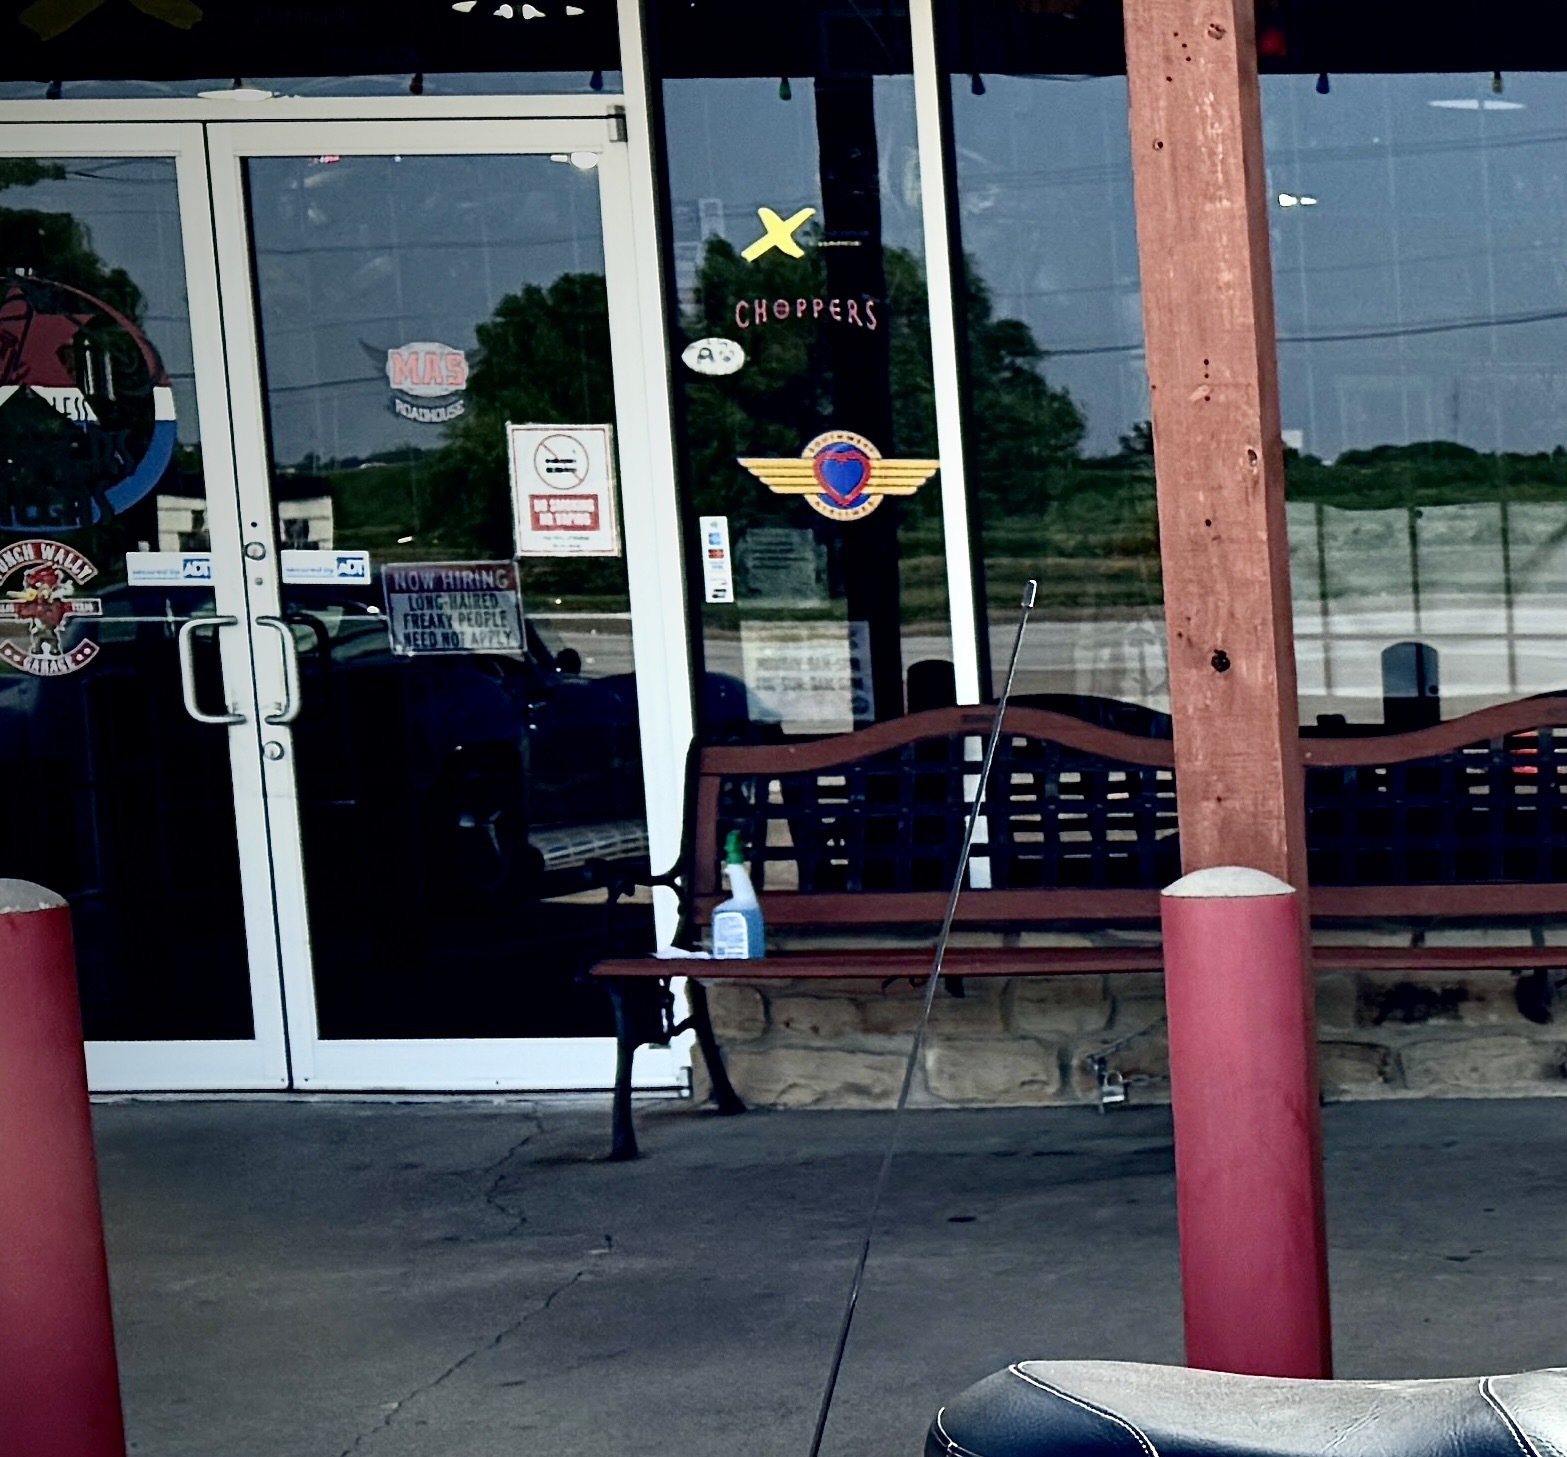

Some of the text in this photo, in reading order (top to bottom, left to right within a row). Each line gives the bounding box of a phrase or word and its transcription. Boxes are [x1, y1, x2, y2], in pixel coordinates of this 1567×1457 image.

[735, 298, 877, 331] CHOPPERS
[395, 399, 465, 423] ROADHOUSE
[0, 543, 93, 582] UNCH WALLY
[184, 558, 212, 579] ADT
[337, 557, 365, 578] ADT
[393, 569, 509, 591] NOW HIRING
[403, 610, 507, 630] FREAKY PEOPLE
[403, 630, 513, 648] NEED NOT APPLY
